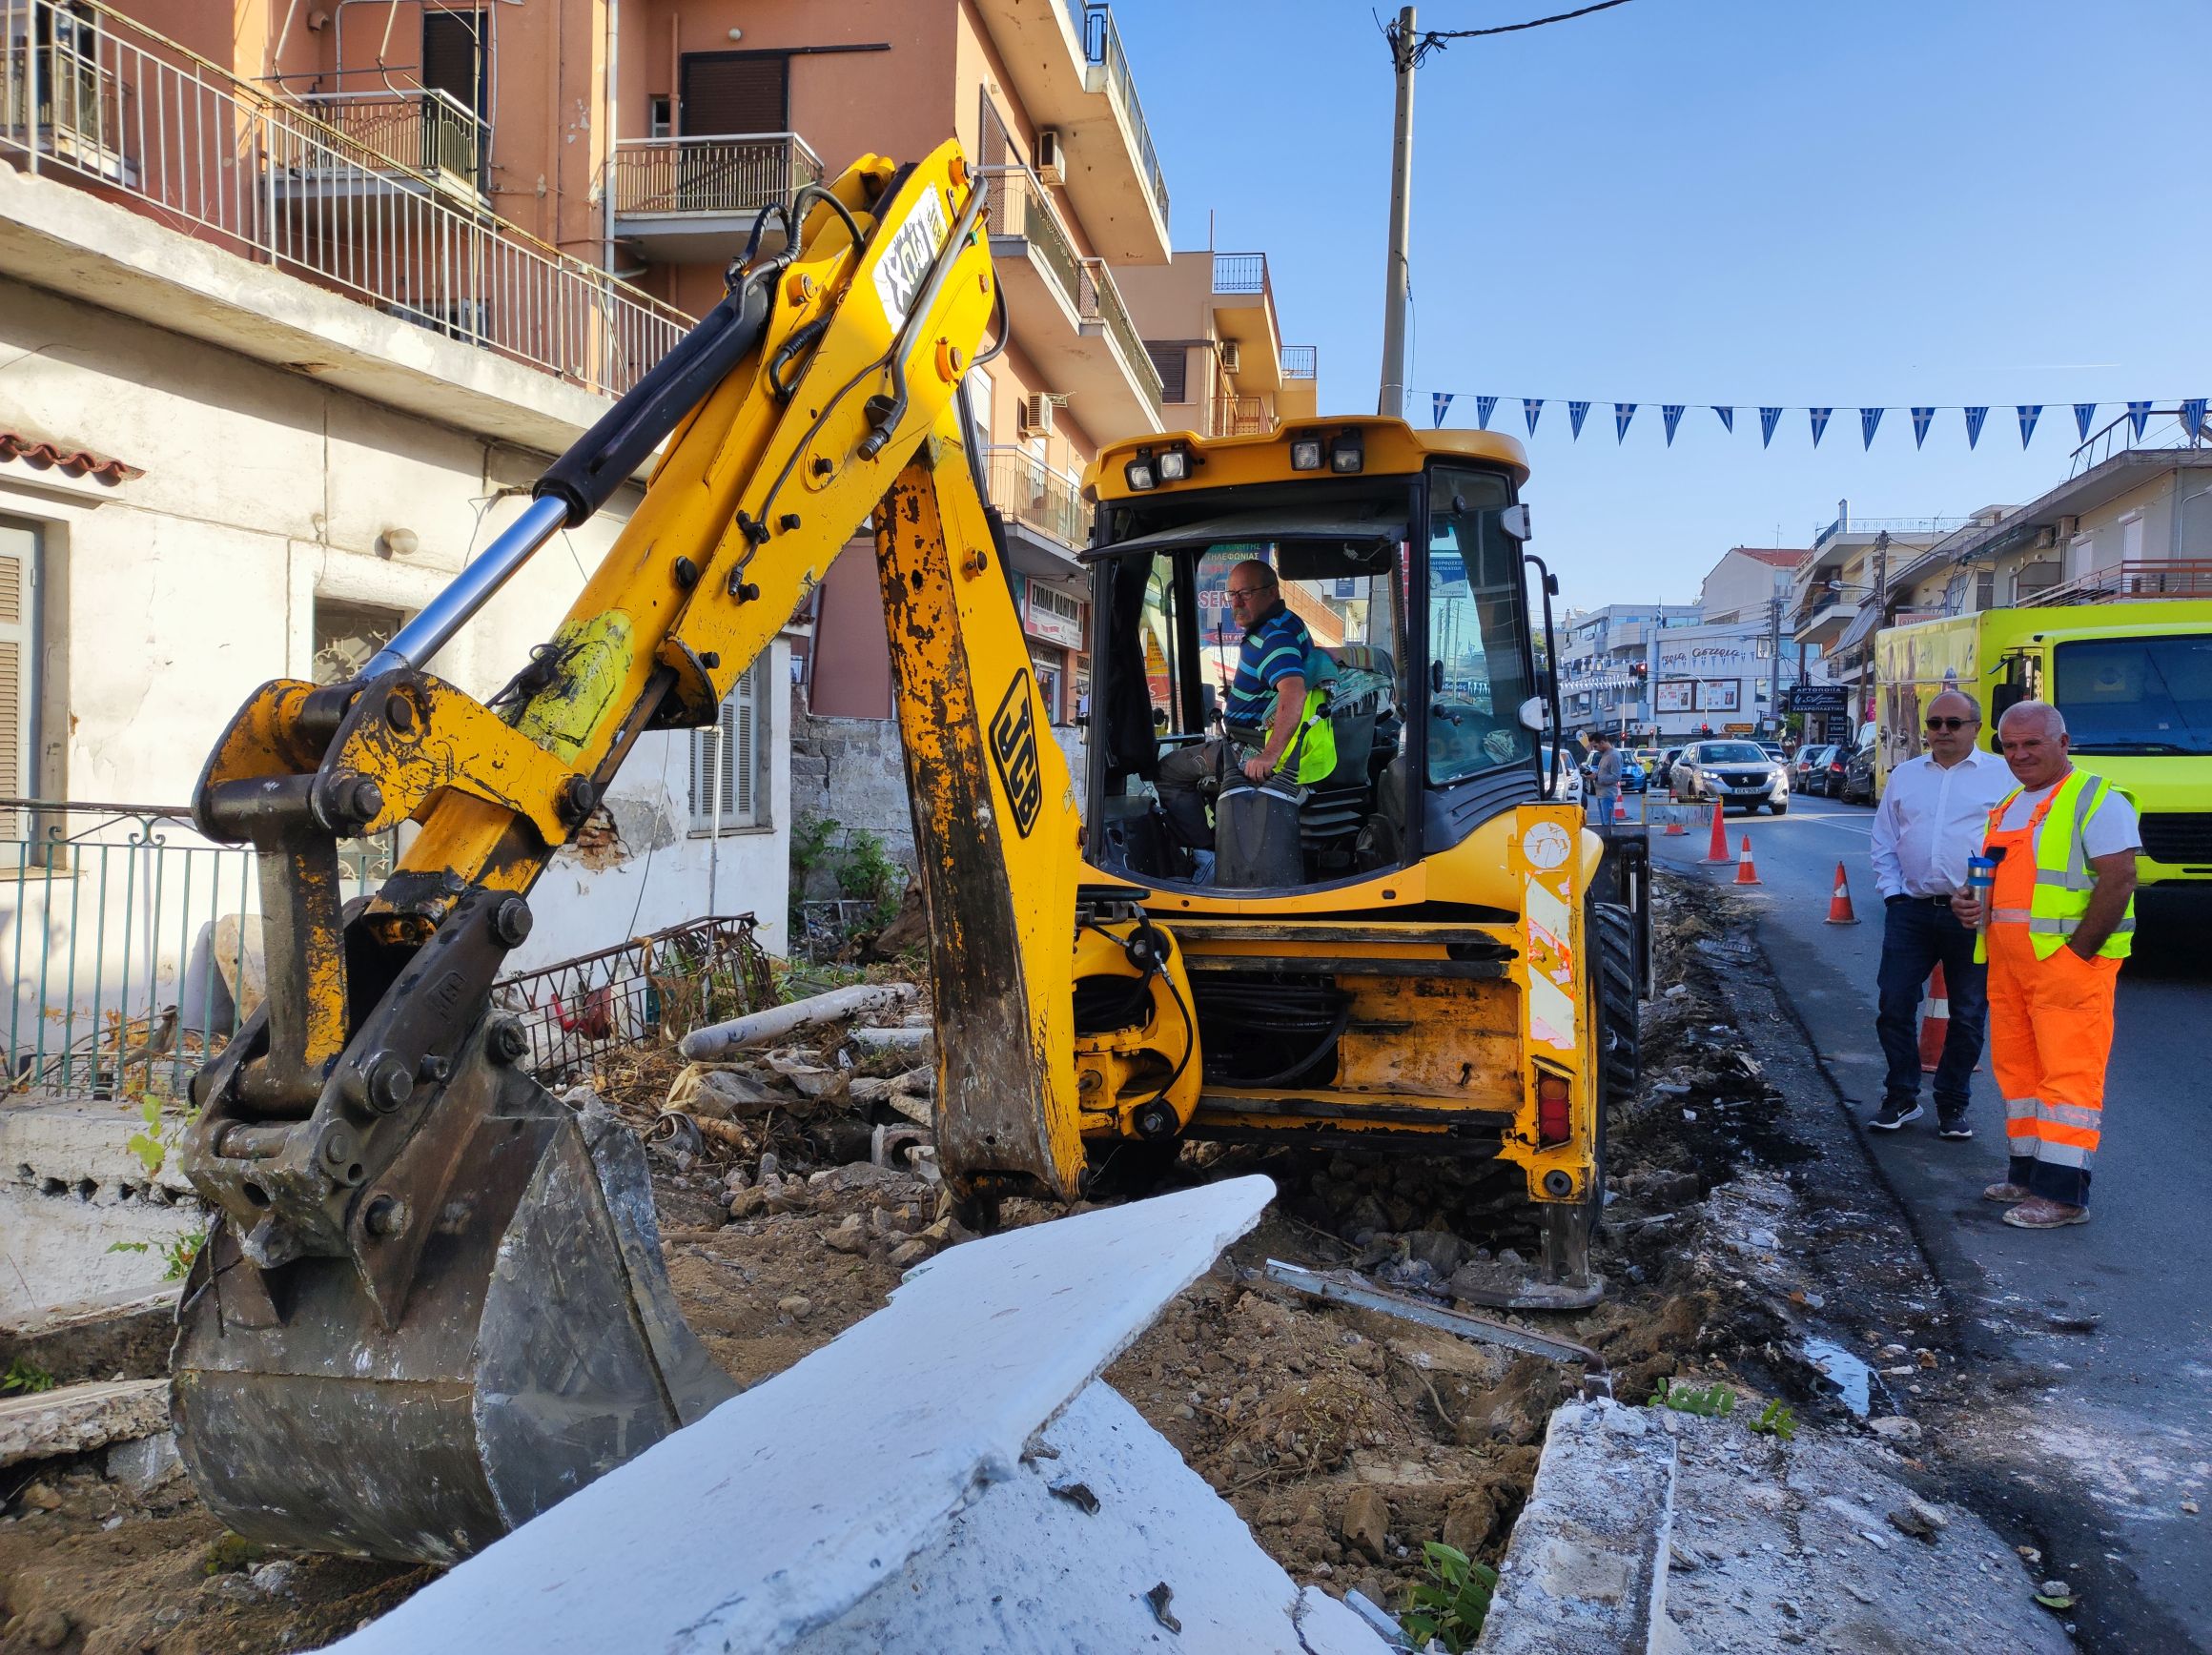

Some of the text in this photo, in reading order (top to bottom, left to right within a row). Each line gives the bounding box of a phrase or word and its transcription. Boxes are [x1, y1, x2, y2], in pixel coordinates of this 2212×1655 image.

[1206, 552, 1260, 561] ΤΗΛΕΦΩΝΙΑΣ
[1198, 589, 1234, 609] SER
[996, 696, 1040, 827] JCB
